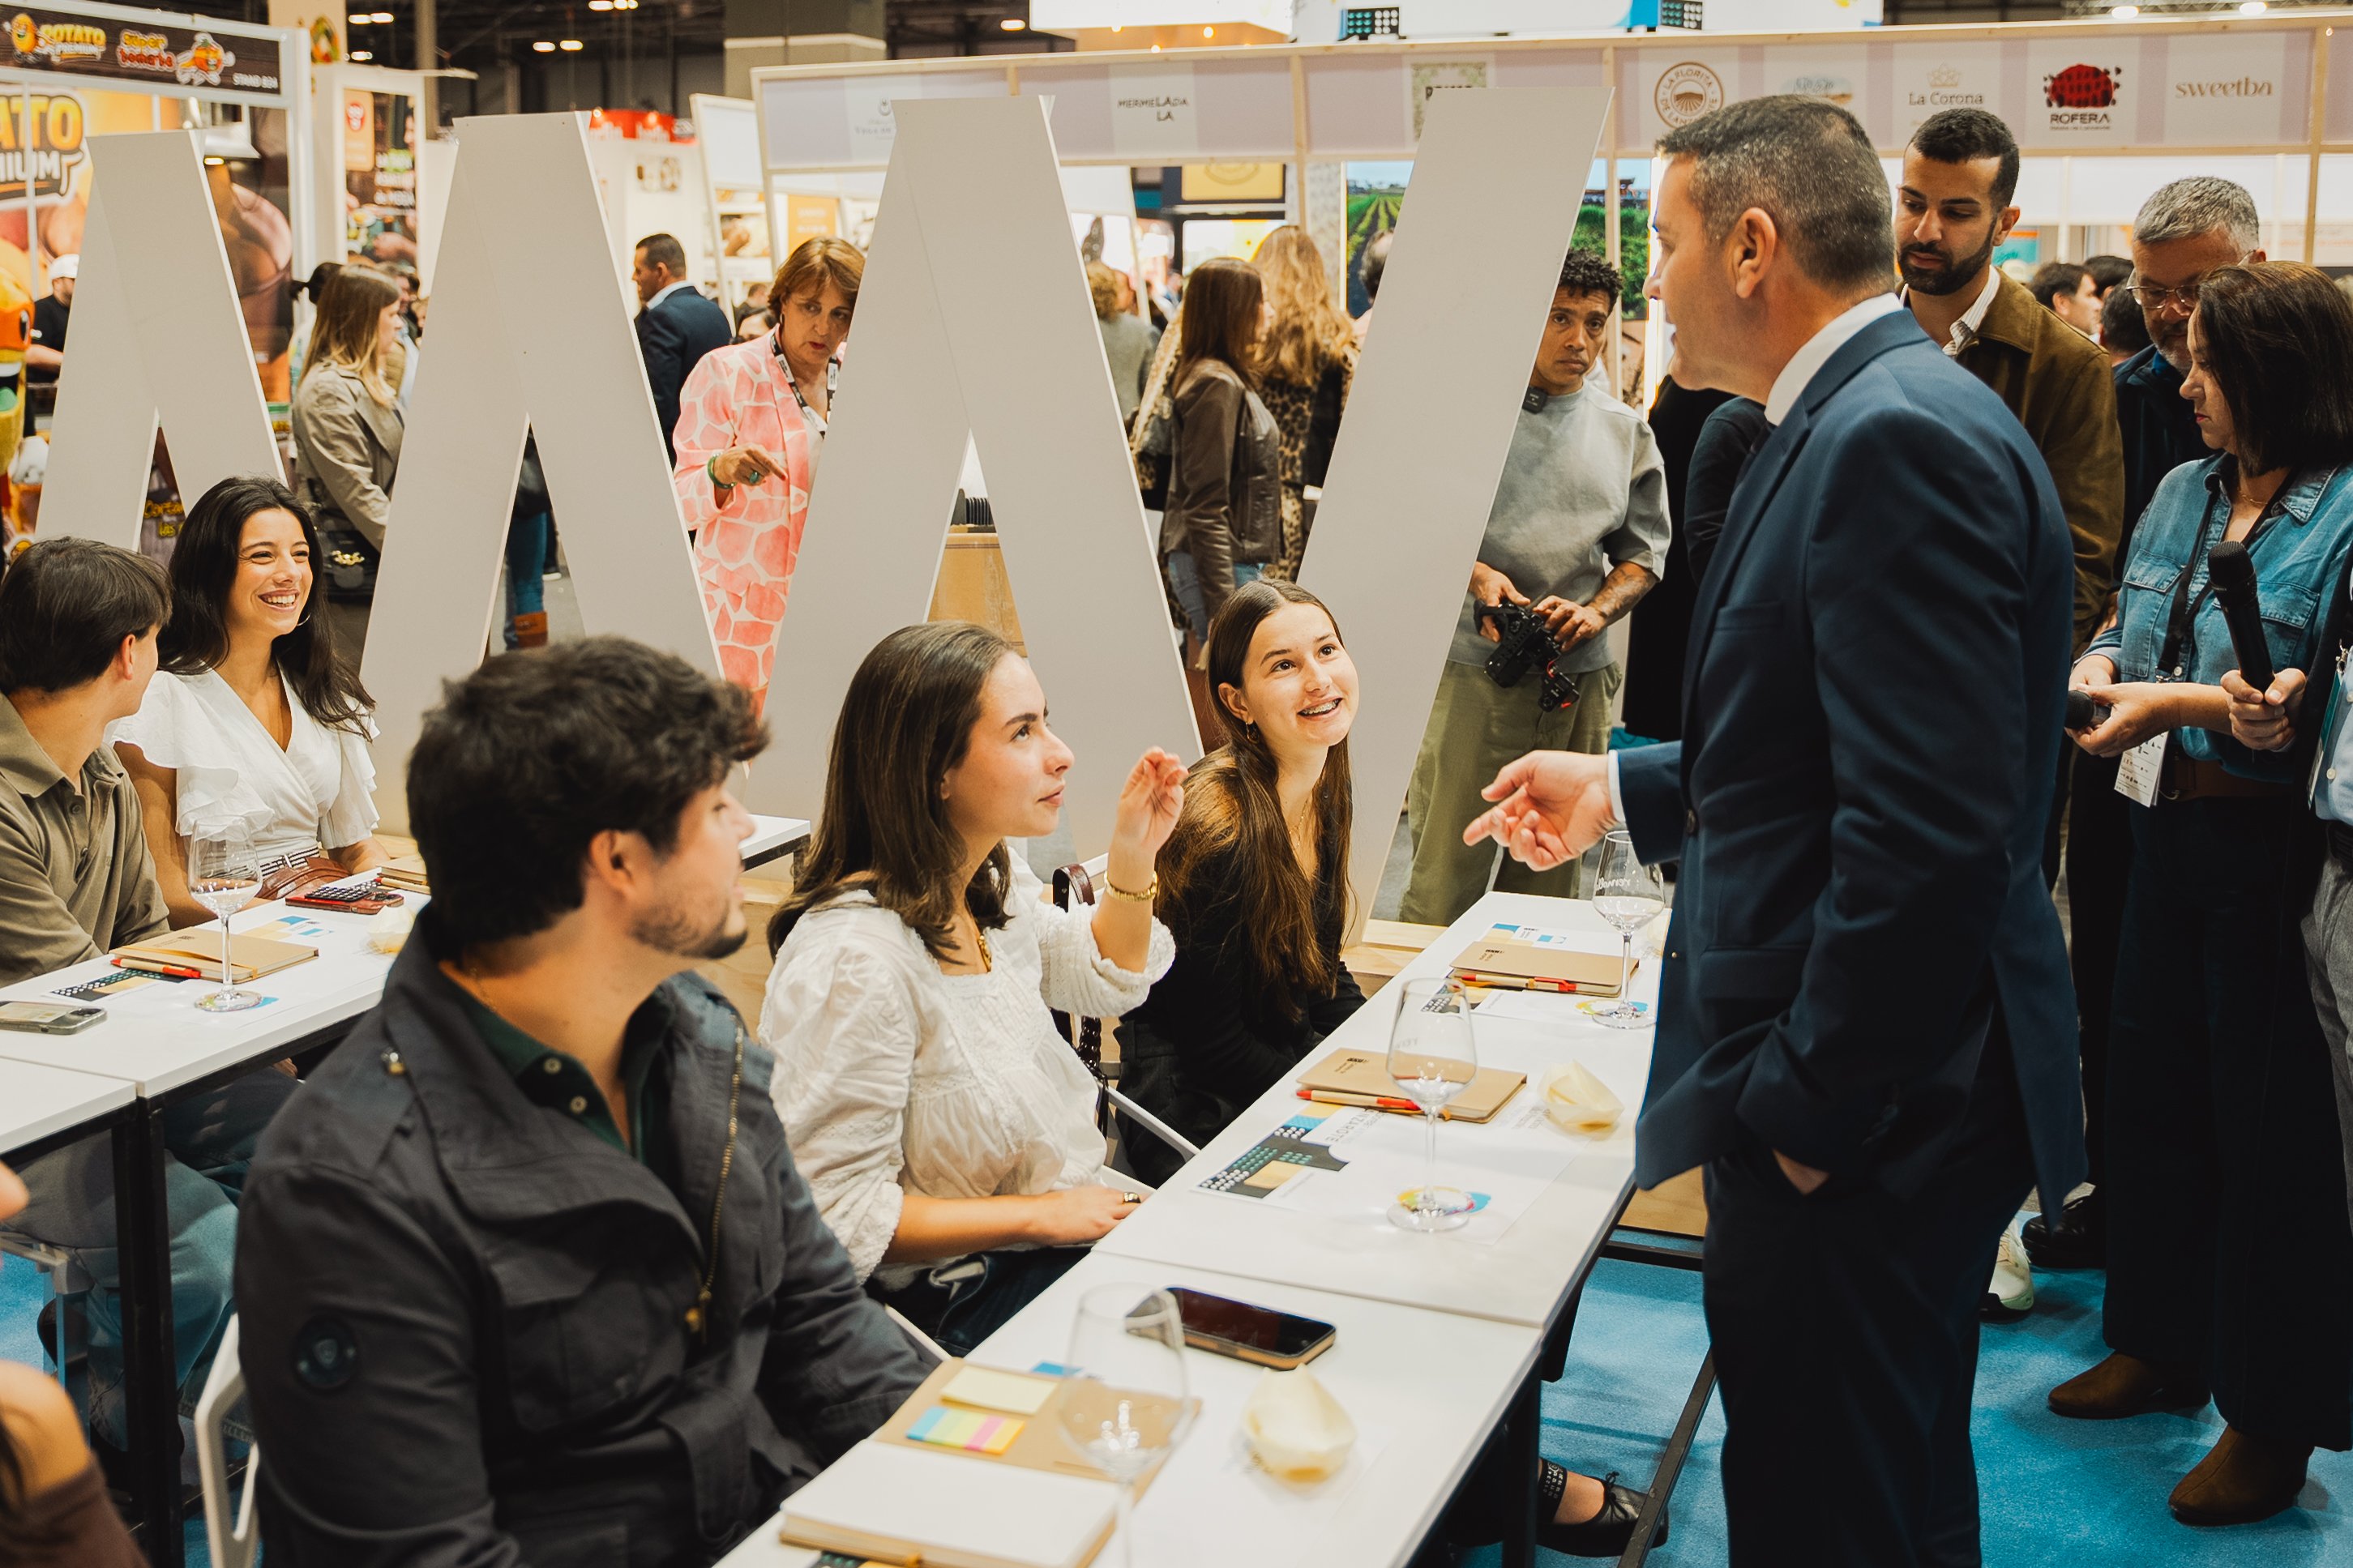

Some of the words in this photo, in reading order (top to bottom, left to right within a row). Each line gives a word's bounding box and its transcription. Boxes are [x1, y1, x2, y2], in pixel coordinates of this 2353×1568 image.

[41, 24, 106, 45] POTATO
[1118, 95, 1189, 108] MERMELADA
[1909, 92, 1925, 105] La
[1930, 91, 1983, 105] Corona
[1157, 111, 1174, 122] LA
[2050, 113, 2110, 124] ROFERA
